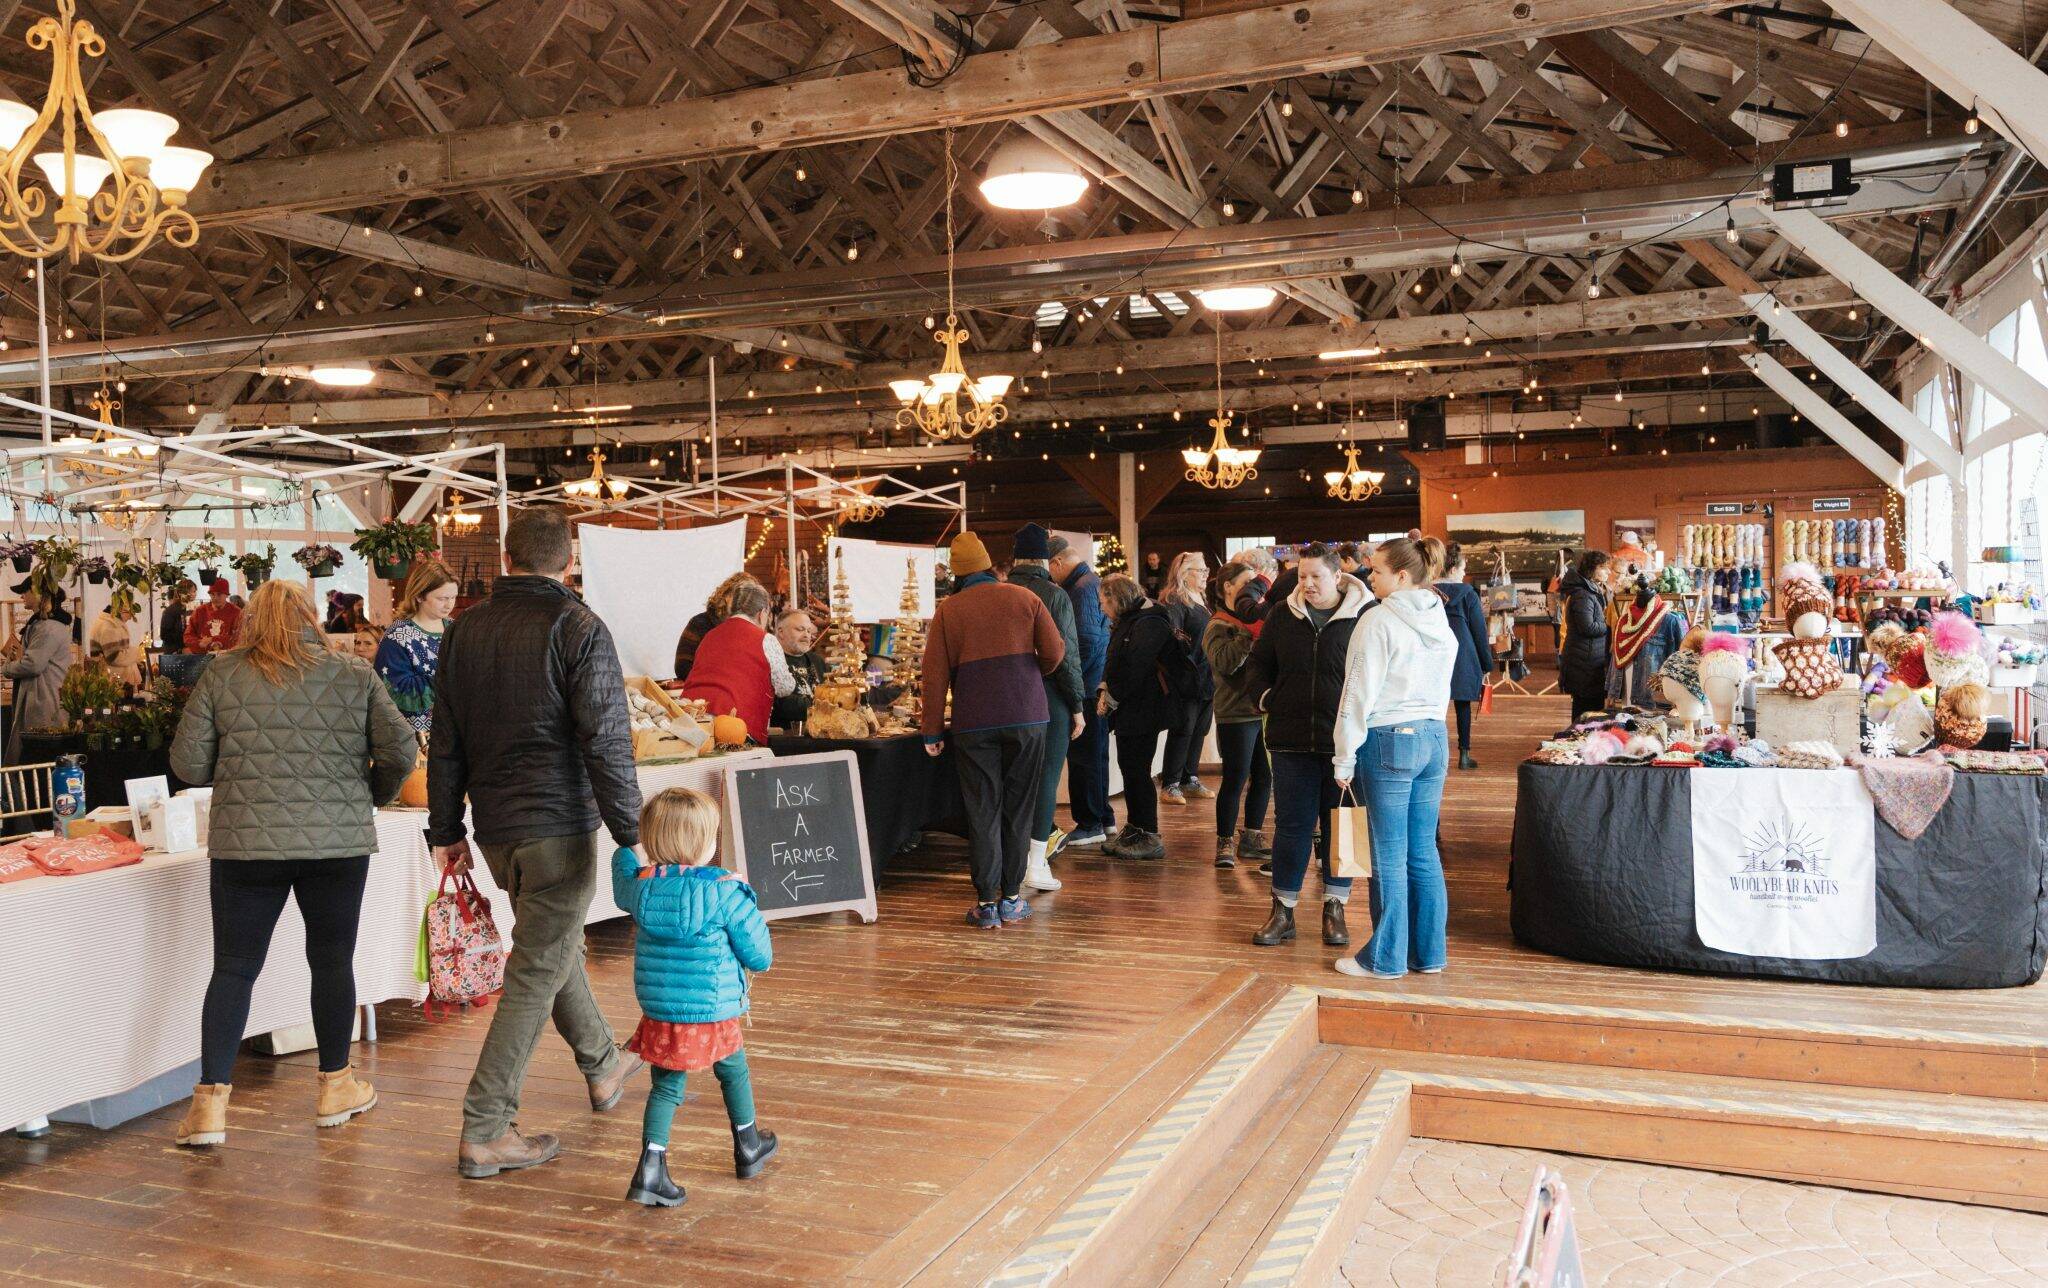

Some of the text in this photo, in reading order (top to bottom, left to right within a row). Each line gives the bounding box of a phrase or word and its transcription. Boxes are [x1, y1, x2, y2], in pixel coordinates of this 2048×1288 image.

[776, 778, 820, 808] ASK
[794, 813, 809, 837] A
[771, 842, 838, 866] FARMER
[1730, 876, 1839, 895] WOOLYBEAR KNITS
